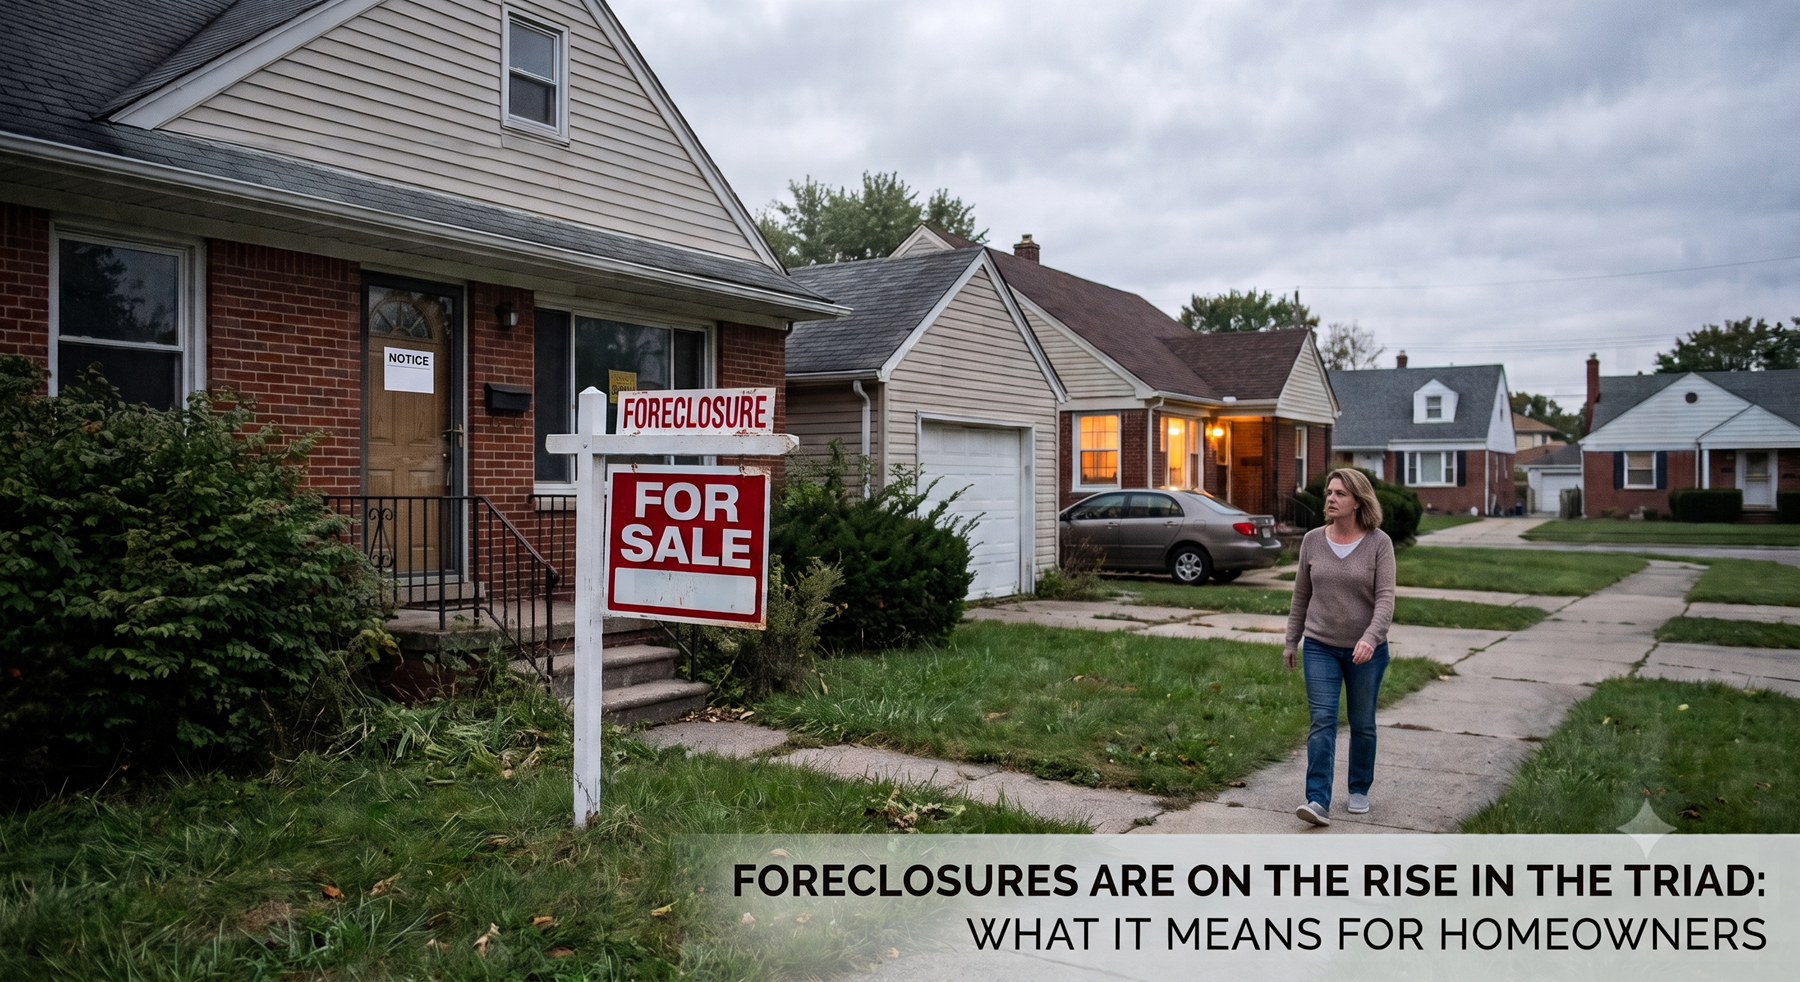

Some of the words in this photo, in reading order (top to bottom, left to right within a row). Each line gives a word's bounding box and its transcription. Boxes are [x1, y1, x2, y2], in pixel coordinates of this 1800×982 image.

[389, 353, 429, 366] NOTICE
[623, 395, 768, 429] FORECLOSURE
[635, 481, 739, 523] FOR
[620, 523, 752, 569] SALE
